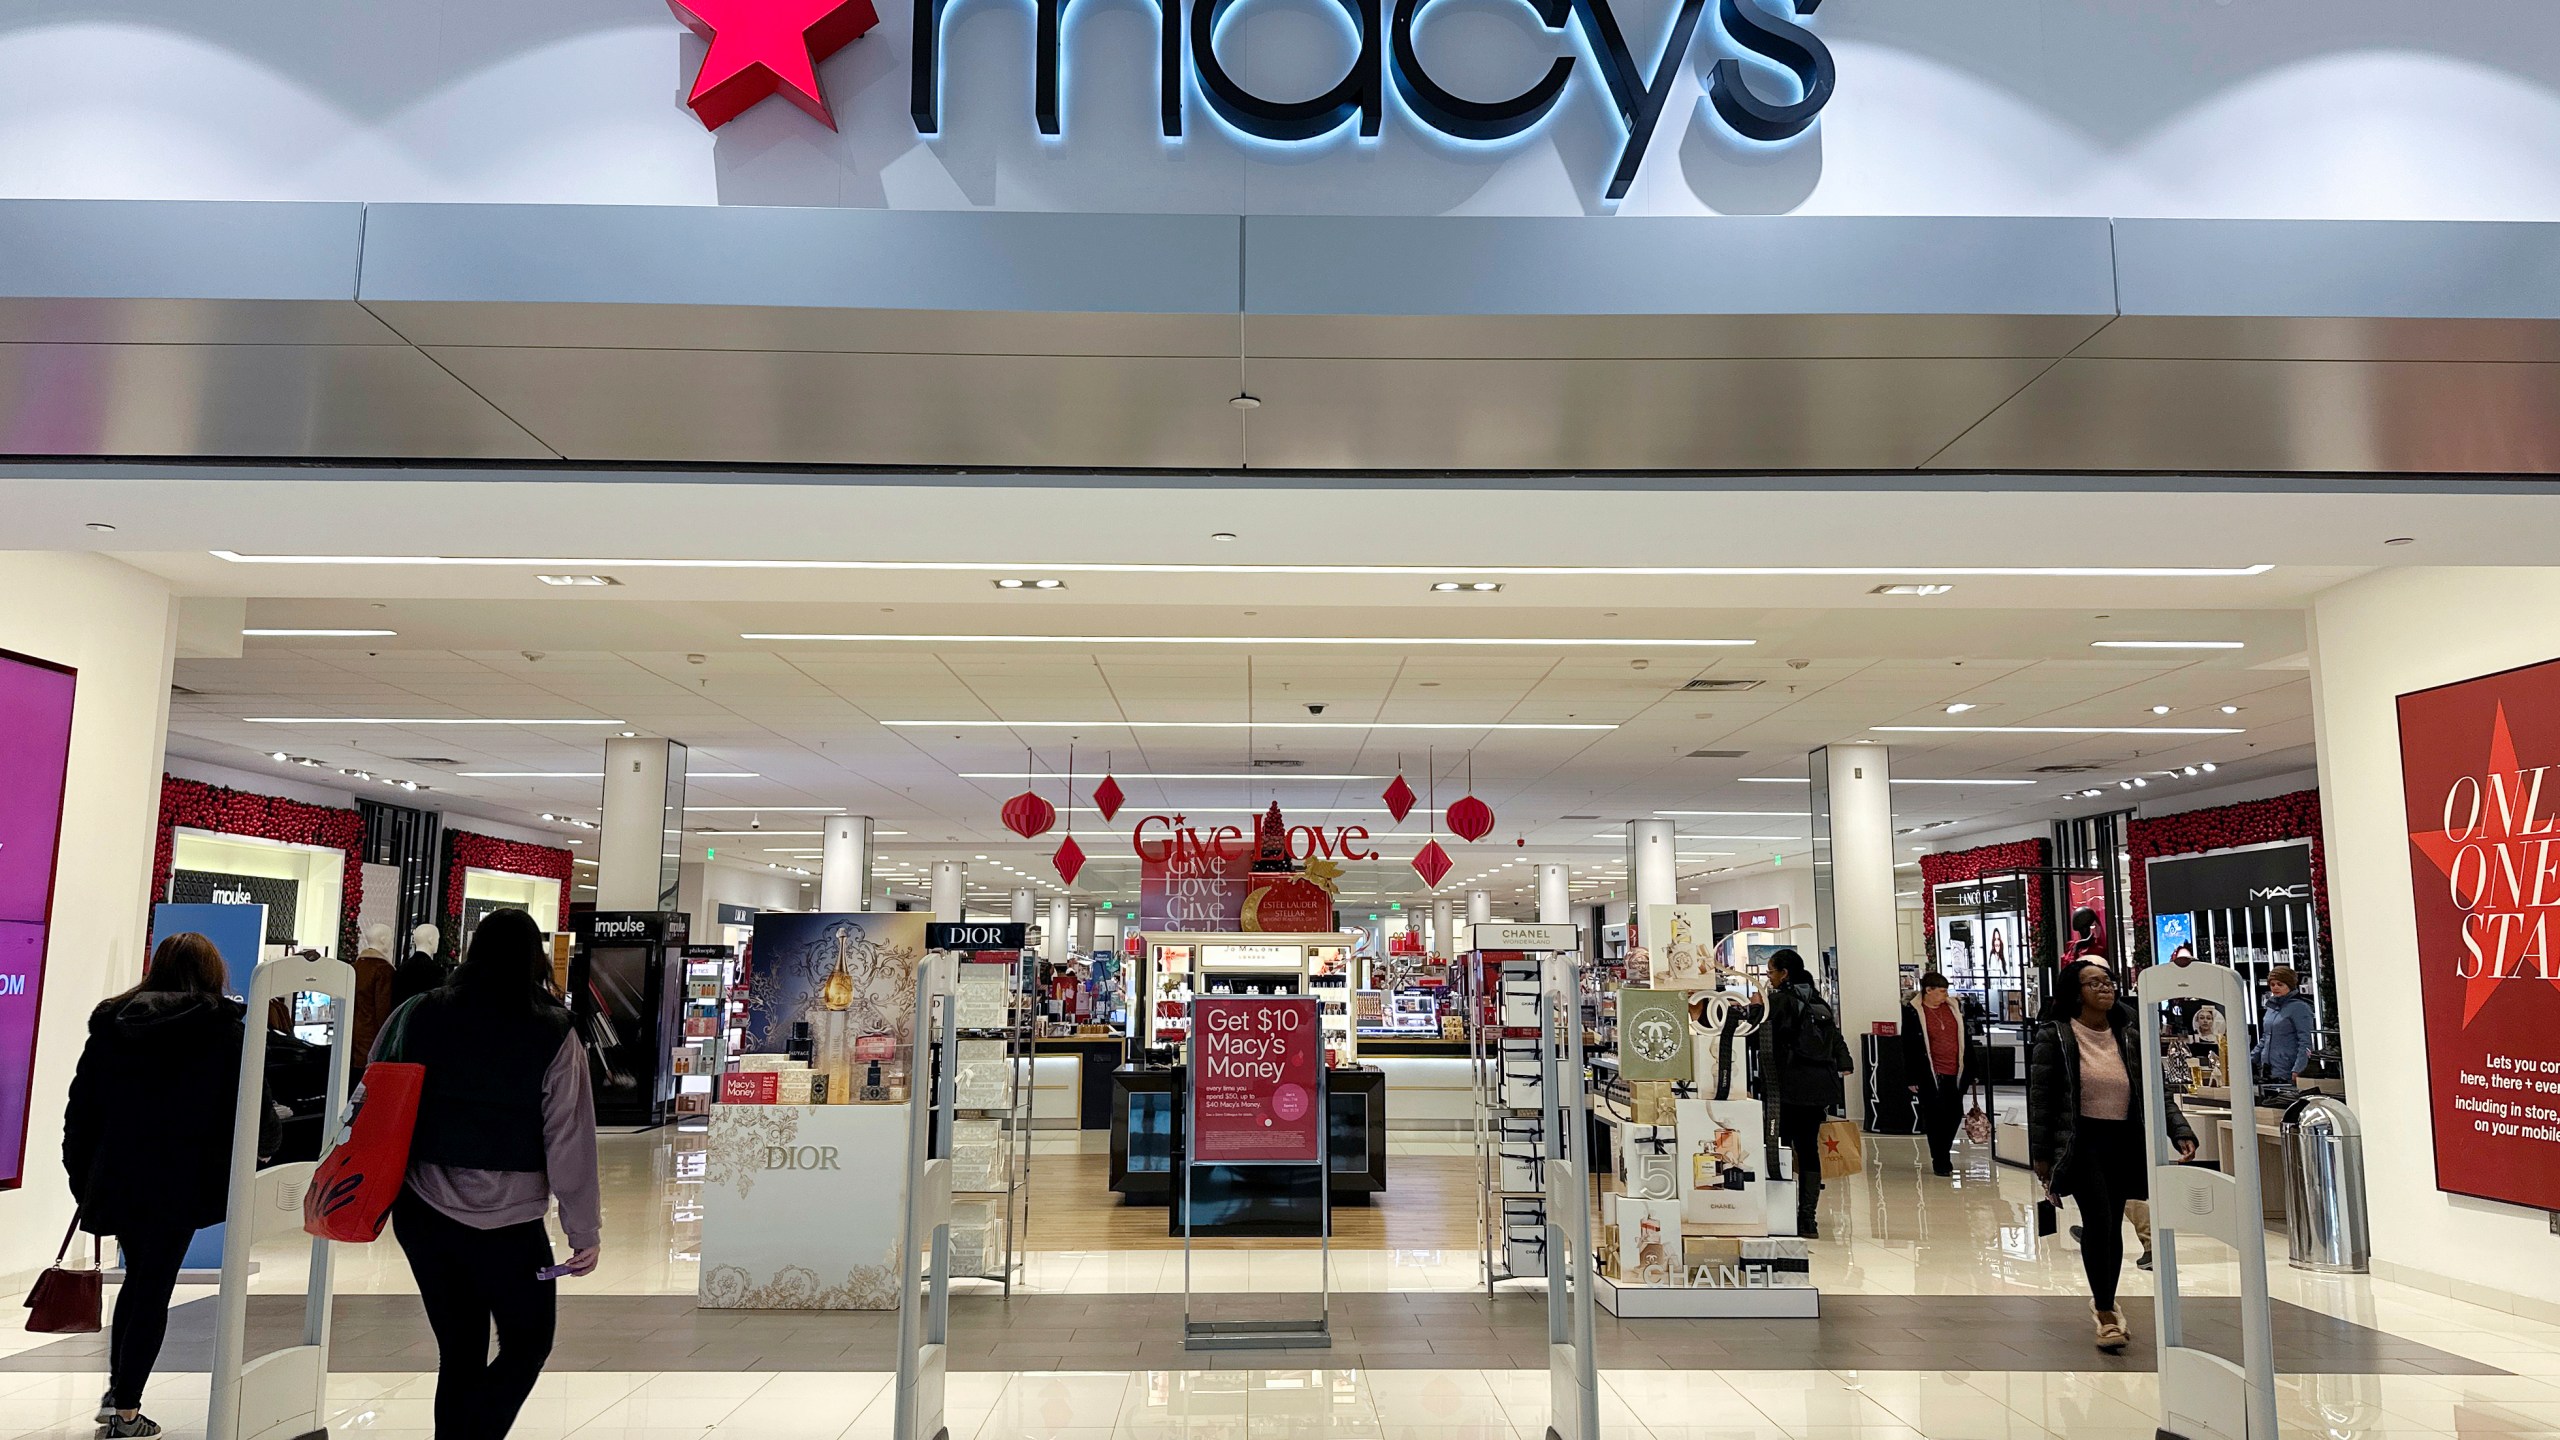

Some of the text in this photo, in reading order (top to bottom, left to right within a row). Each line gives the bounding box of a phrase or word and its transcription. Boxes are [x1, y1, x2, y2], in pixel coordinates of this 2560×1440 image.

[2443, 764, 2560, 842] ONL
[1133, 812, 1379, 864] Give Love.
[1168, 850, 1227, 875] Give
[2450, 838, 2560, 911] ONE
[212, 883, 251, 905] impulse
[1165, 871, 1232, 896] Love.
[735, 909, 747, 921] DIOR
[1166, 896, 1225, 921] Give
[595, 915, 645, 937] impulse
[949, 928, 1002, 944] DIOR
[1502, 929, 1550, 938] CHANEL
[2455, 911, 2560, 979] STA
[1208, 1007, 1299, 1033] Get $10
[1207, 1032, 1286, 1060] Macy's
[1207, 1056, 1286, 1083] Money
[2487, 1053, 2511, 1069] Lets
[2515, 1058, 2537, 1073] you
[728, 1080, 755, 1090] Macy's
[2460, 1070, 2489, 1089] here,
[2491, 1074, 2523, 1090] there
[727, 1088, 755, 1098] Money
[2455, 1095, 2560, 1124] including in store,
[2474, 1119, 2489, 1132] on
[2491, 1121, 2519, 1136] your
[765, 1146, 840, 1170] DIOR
[1639, 1154, 1676, 1200] 5
[1643, 1264, 1785, 1289] CHANEL
